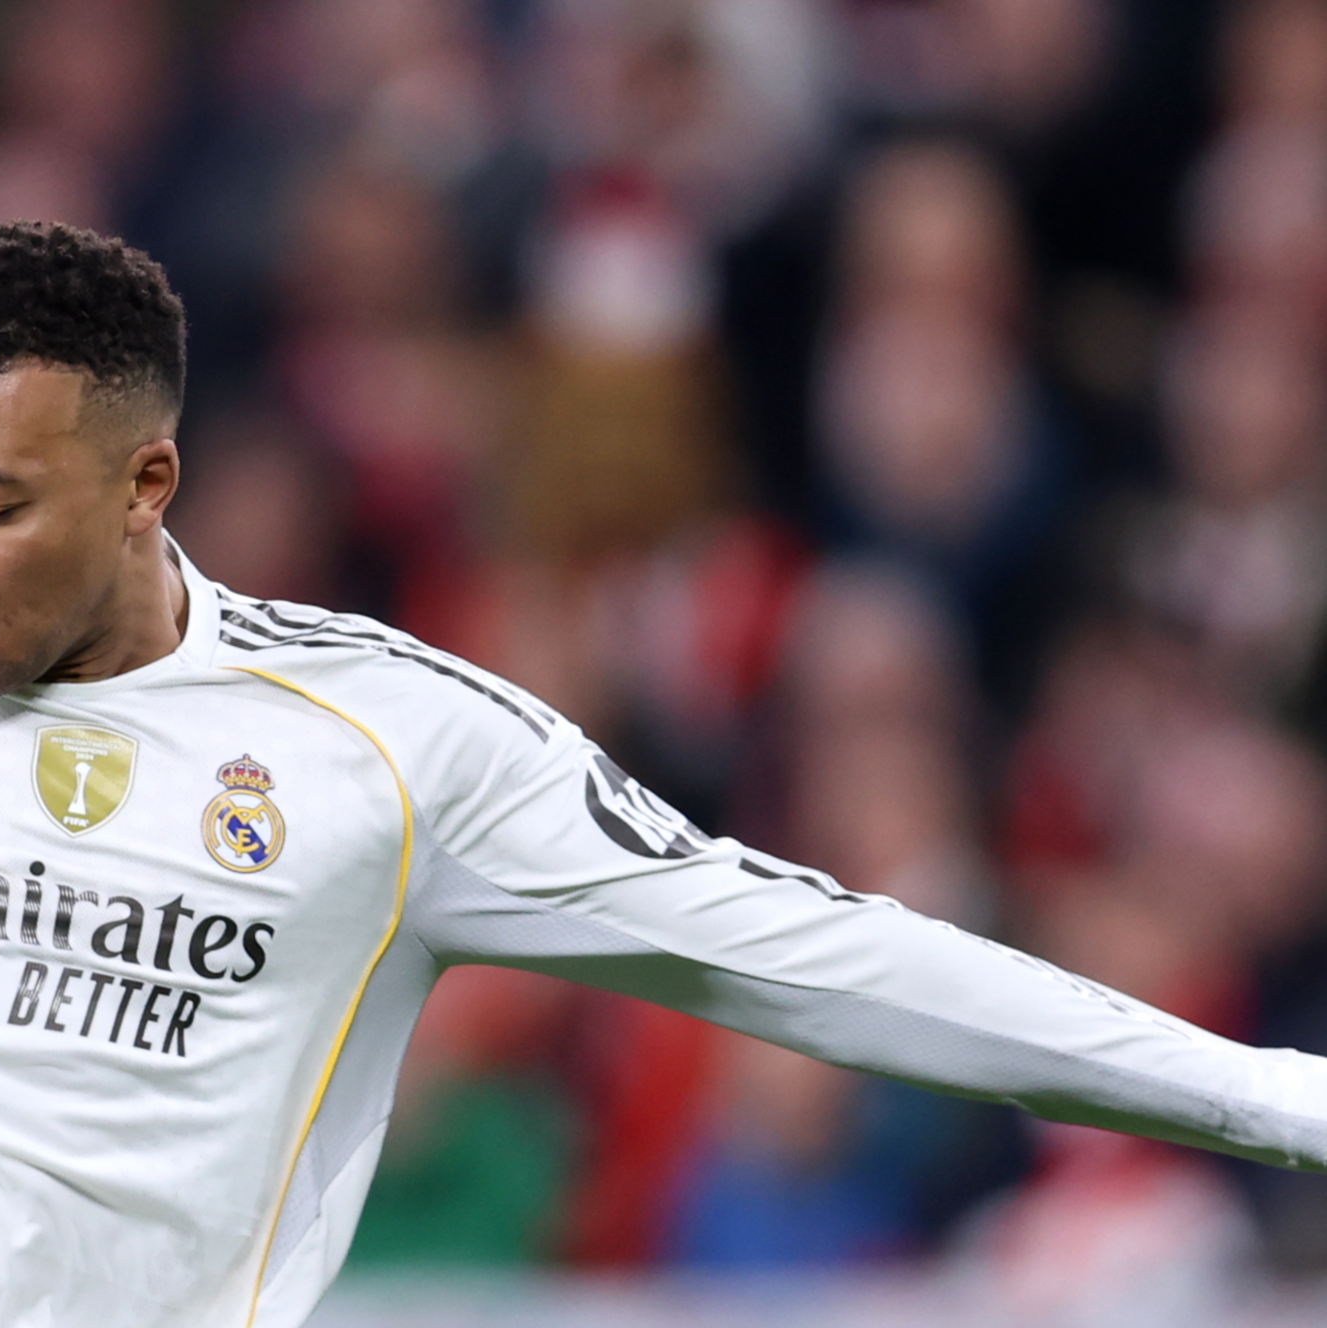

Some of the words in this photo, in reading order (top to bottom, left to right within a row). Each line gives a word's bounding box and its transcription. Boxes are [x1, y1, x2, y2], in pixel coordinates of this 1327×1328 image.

[62, 744, 109, 757] CHAMPIONS
[63, 815, 88, 828] FIFA
[7, 961, 202, 1057] BETTER
